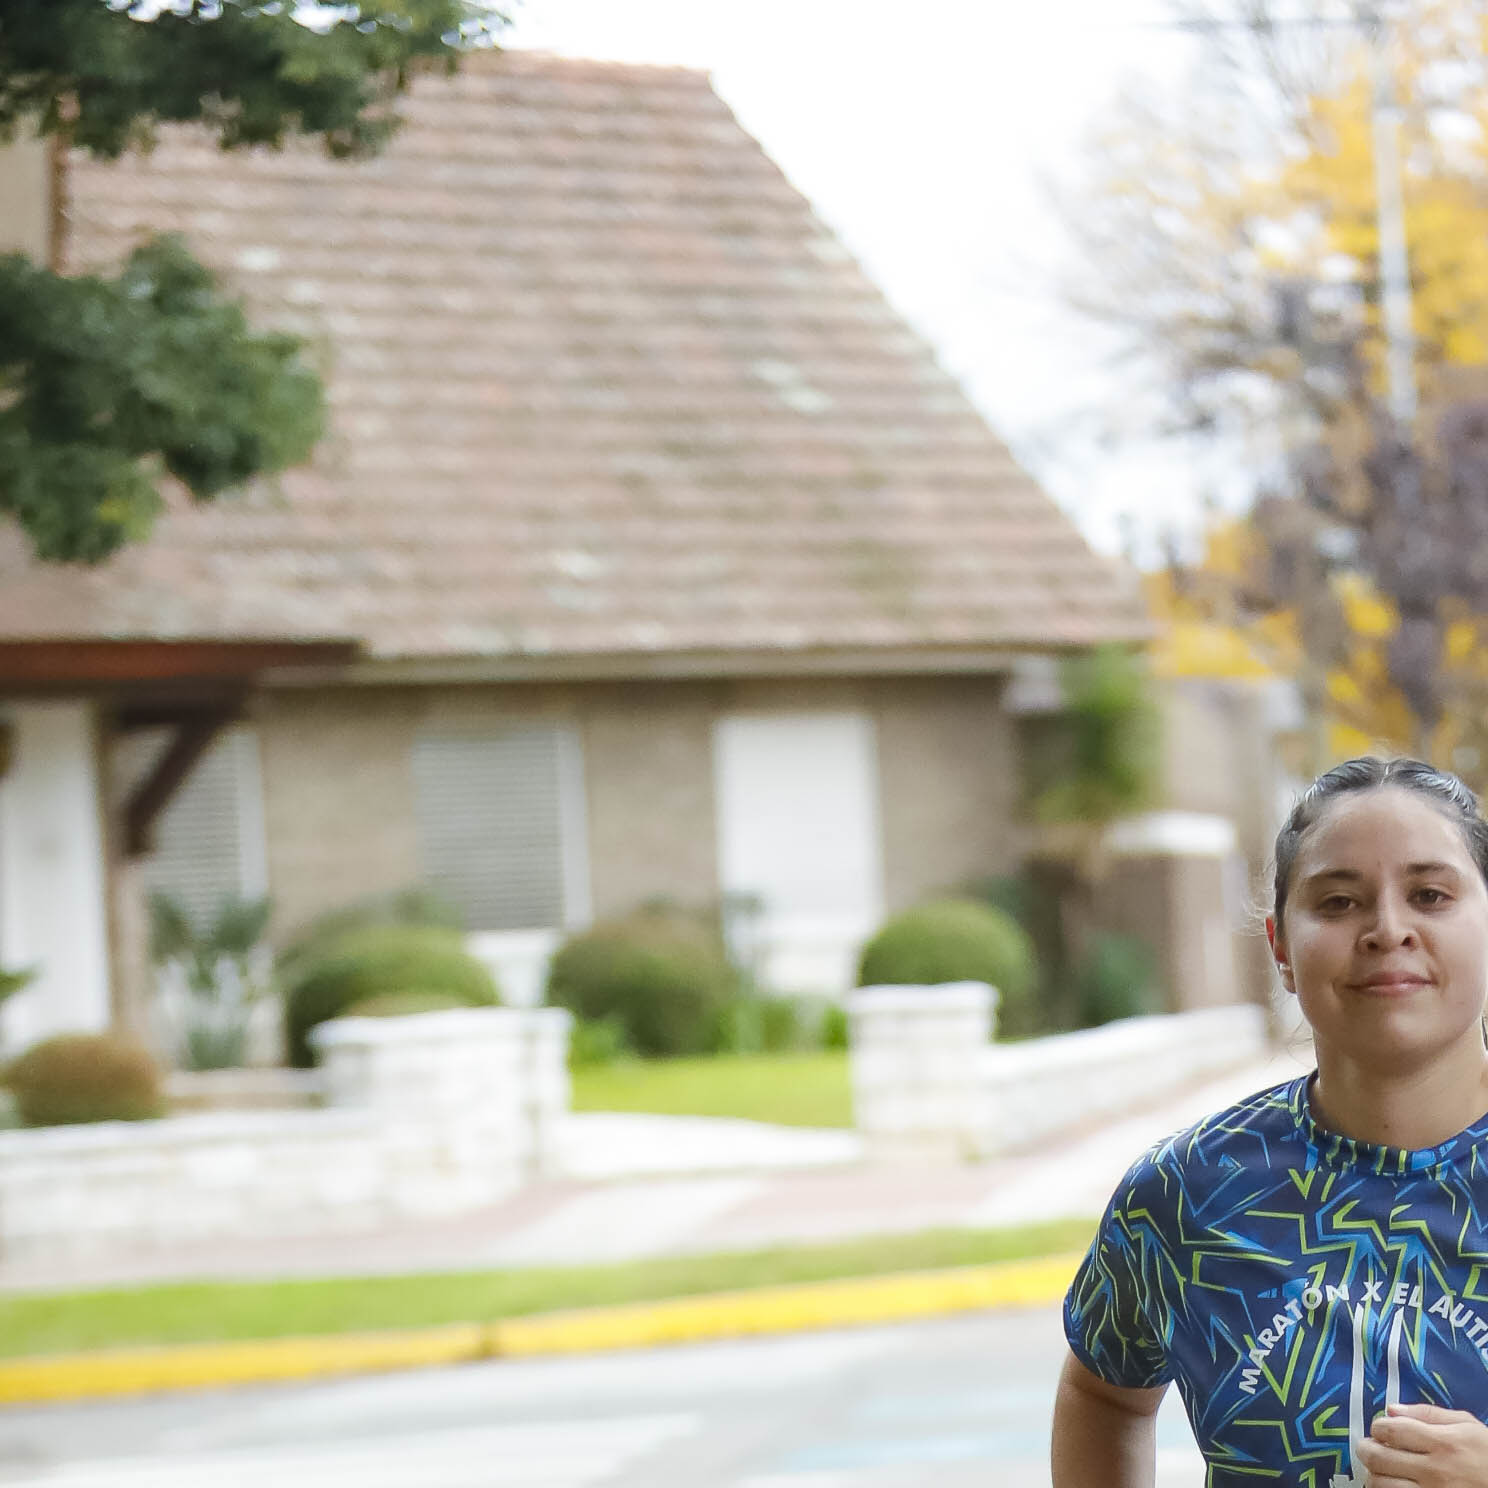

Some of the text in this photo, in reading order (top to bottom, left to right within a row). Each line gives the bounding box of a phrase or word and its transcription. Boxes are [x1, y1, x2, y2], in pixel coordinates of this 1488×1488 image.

[1239, 1281, 1350, 1395] MARATÓN
[1360, 1281, 1384, 1302] X
[1391, 1282, 1423, 1309] EL
